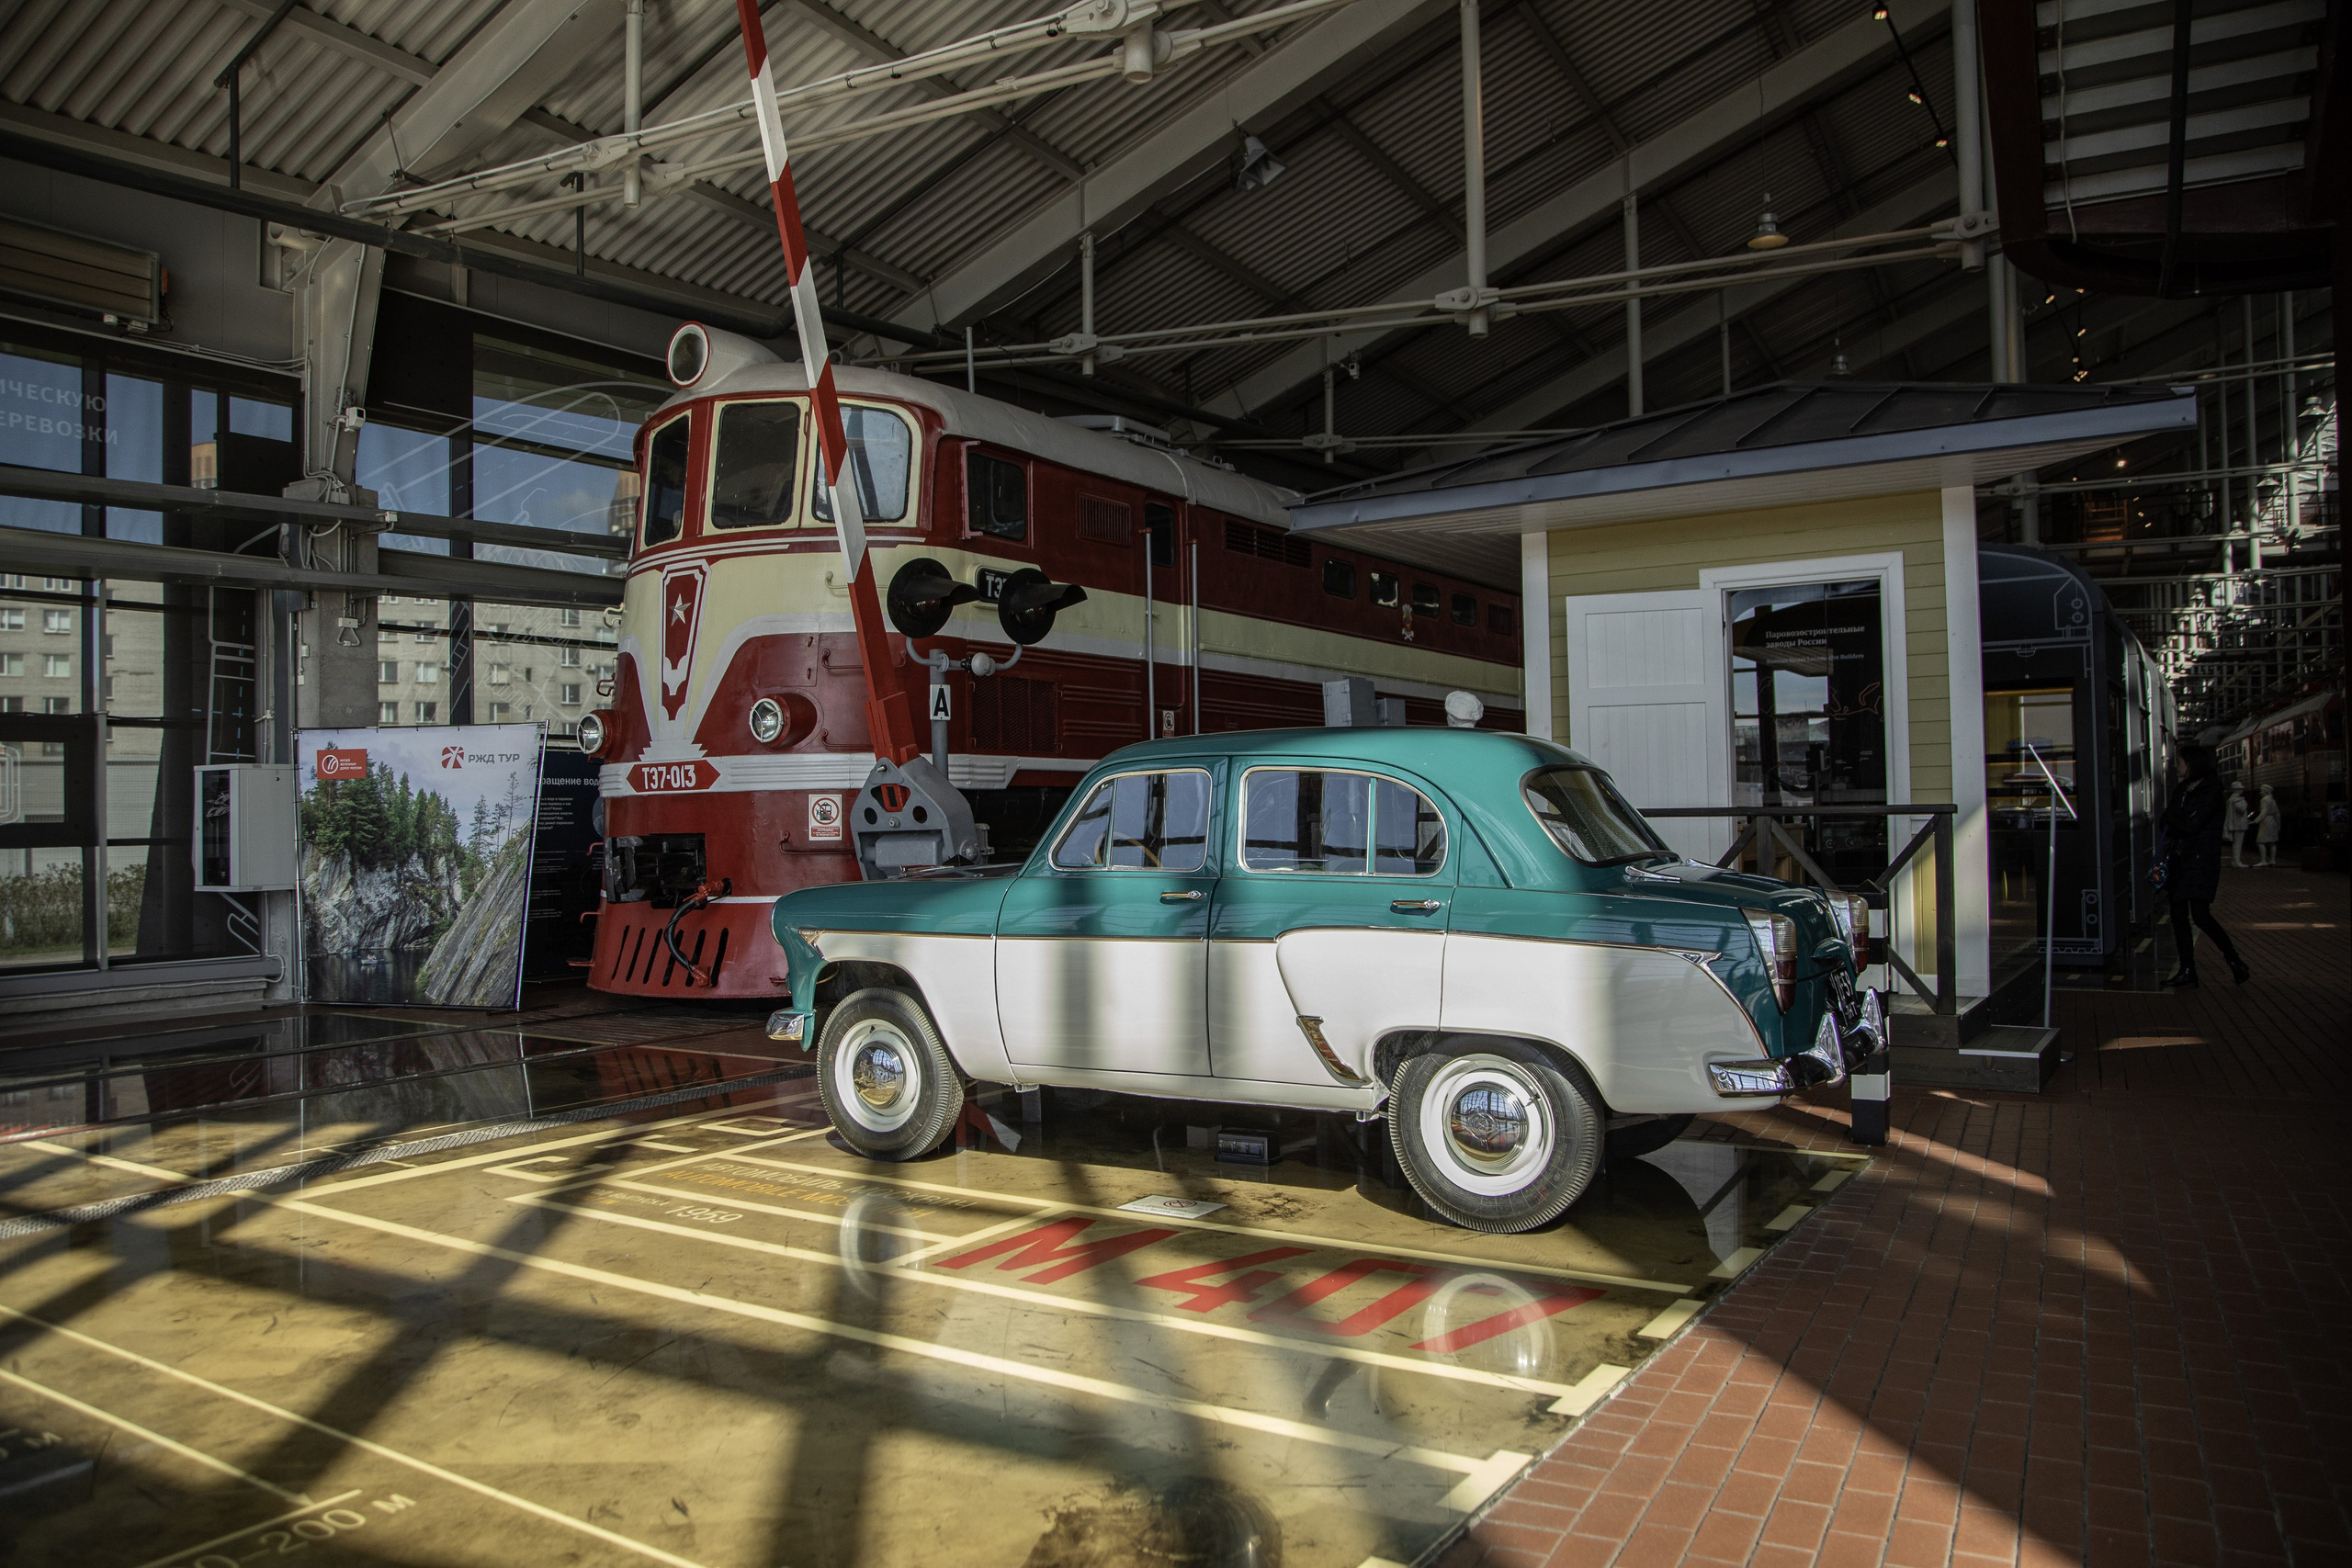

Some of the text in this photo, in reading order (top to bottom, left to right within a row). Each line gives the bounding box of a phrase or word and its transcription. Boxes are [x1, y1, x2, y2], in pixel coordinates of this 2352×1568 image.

[985, 574, 1008, 599] ТЭ
[1766, 637, 1827, 649] заводы России
[468, 753, 520, 764] РЖД ТУР
[641, 764, 696, 790] ТЭ7-013
[657, 1170, 808, 1198] AUTOMOBILE
[694, 1162, 978, 1210] АВТОМОБИЛЬ МОСКВИЧ
[664, 1204, 744, 1224] 1959
